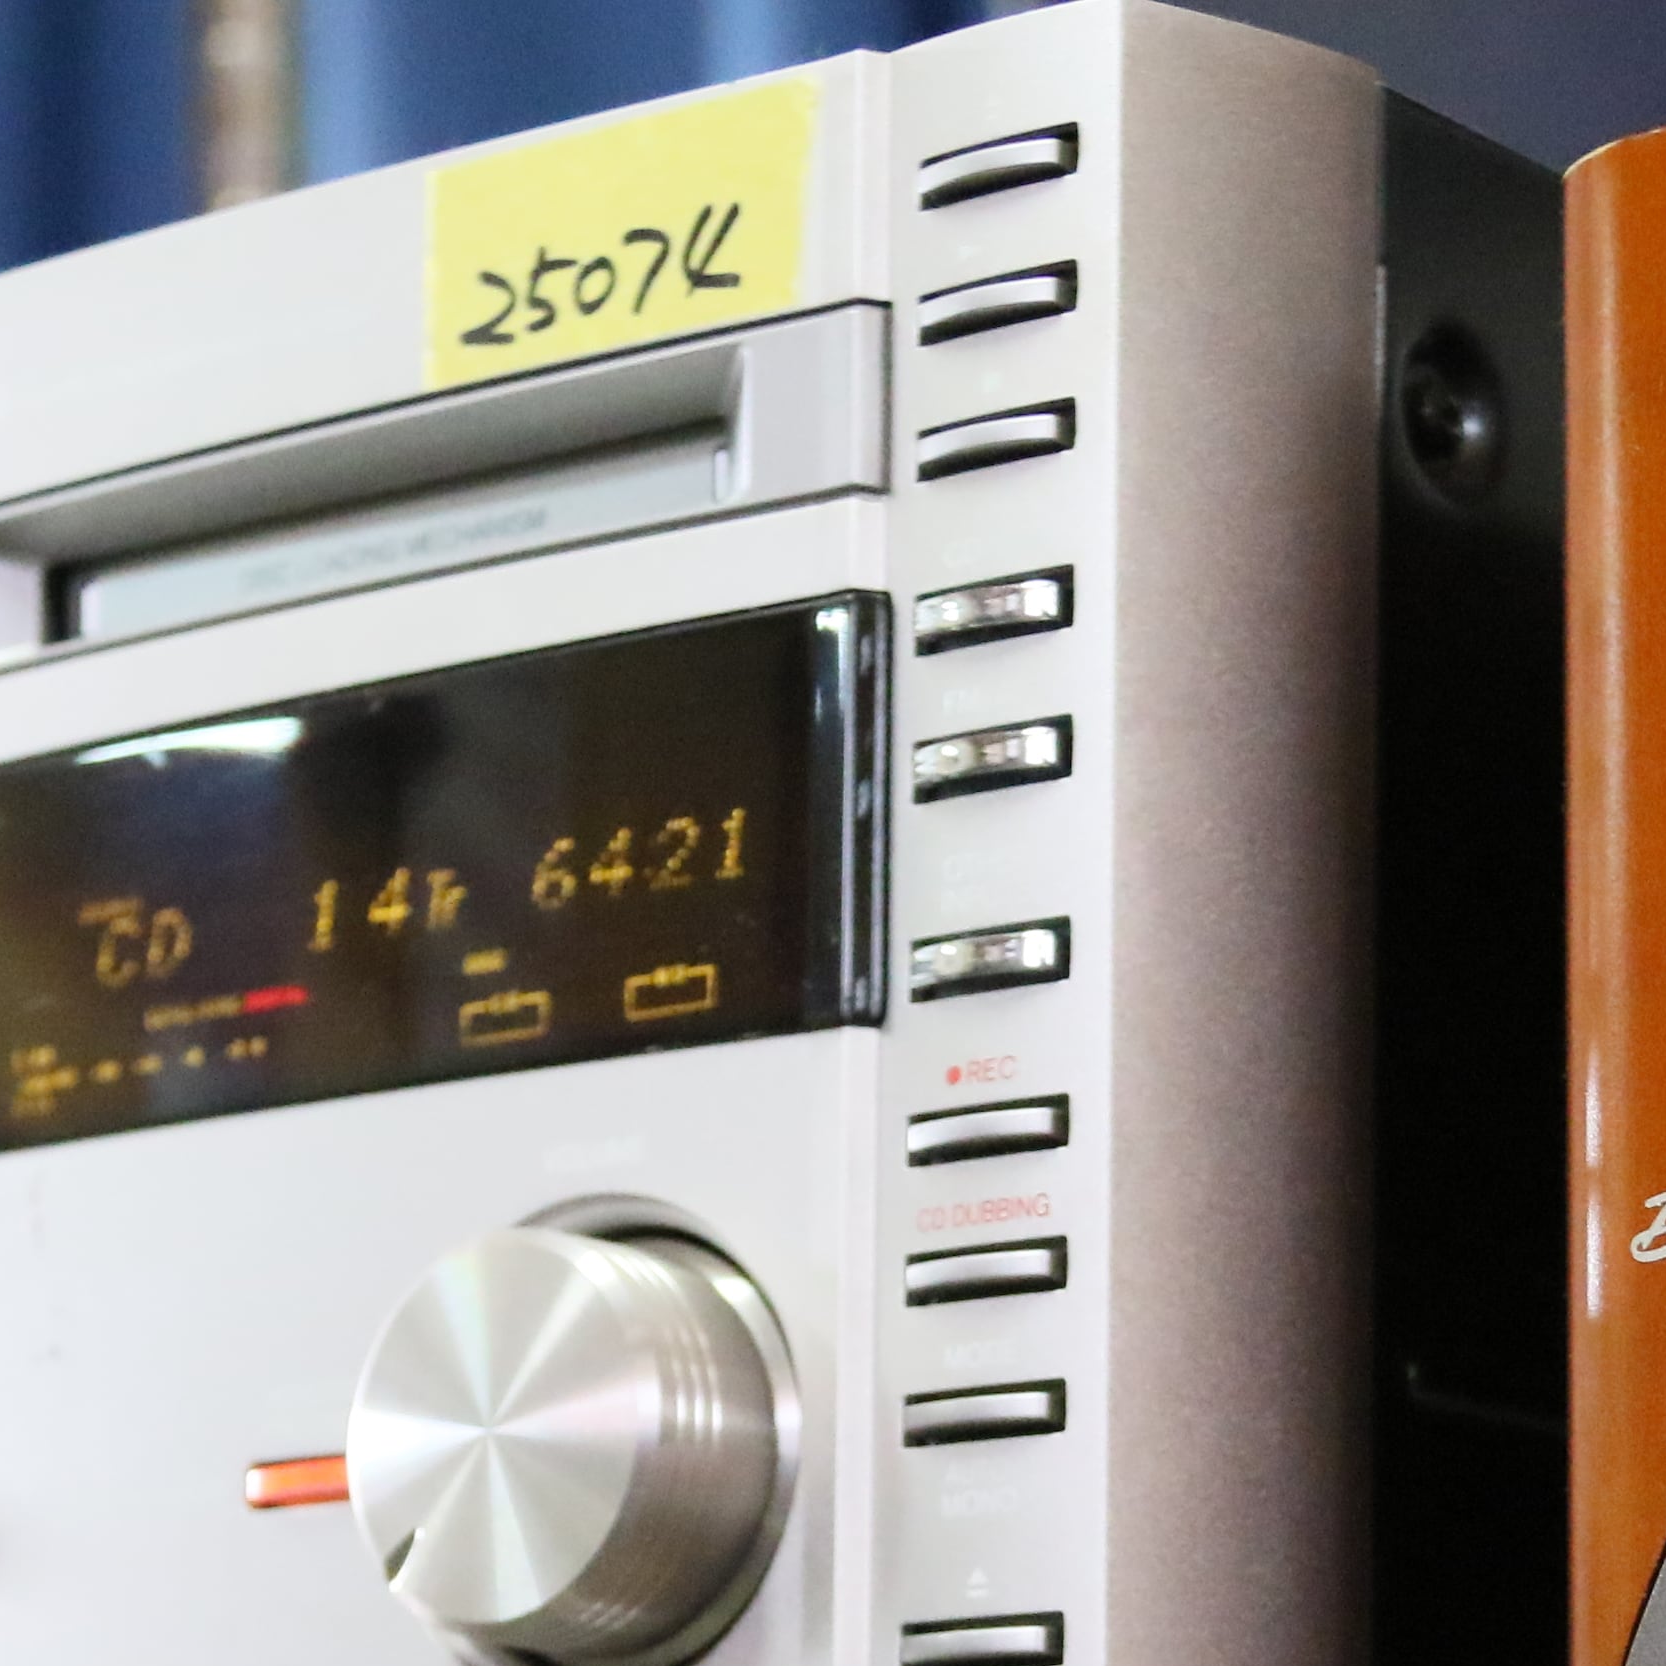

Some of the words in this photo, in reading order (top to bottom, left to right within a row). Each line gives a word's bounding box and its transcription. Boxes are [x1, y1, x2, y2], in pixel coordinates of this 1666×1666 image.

[965, 1054, 1019, 1083] REC
[914, 1206, 946, 1233] CD
[951, 1193, 1052, 1228] DUBBING
